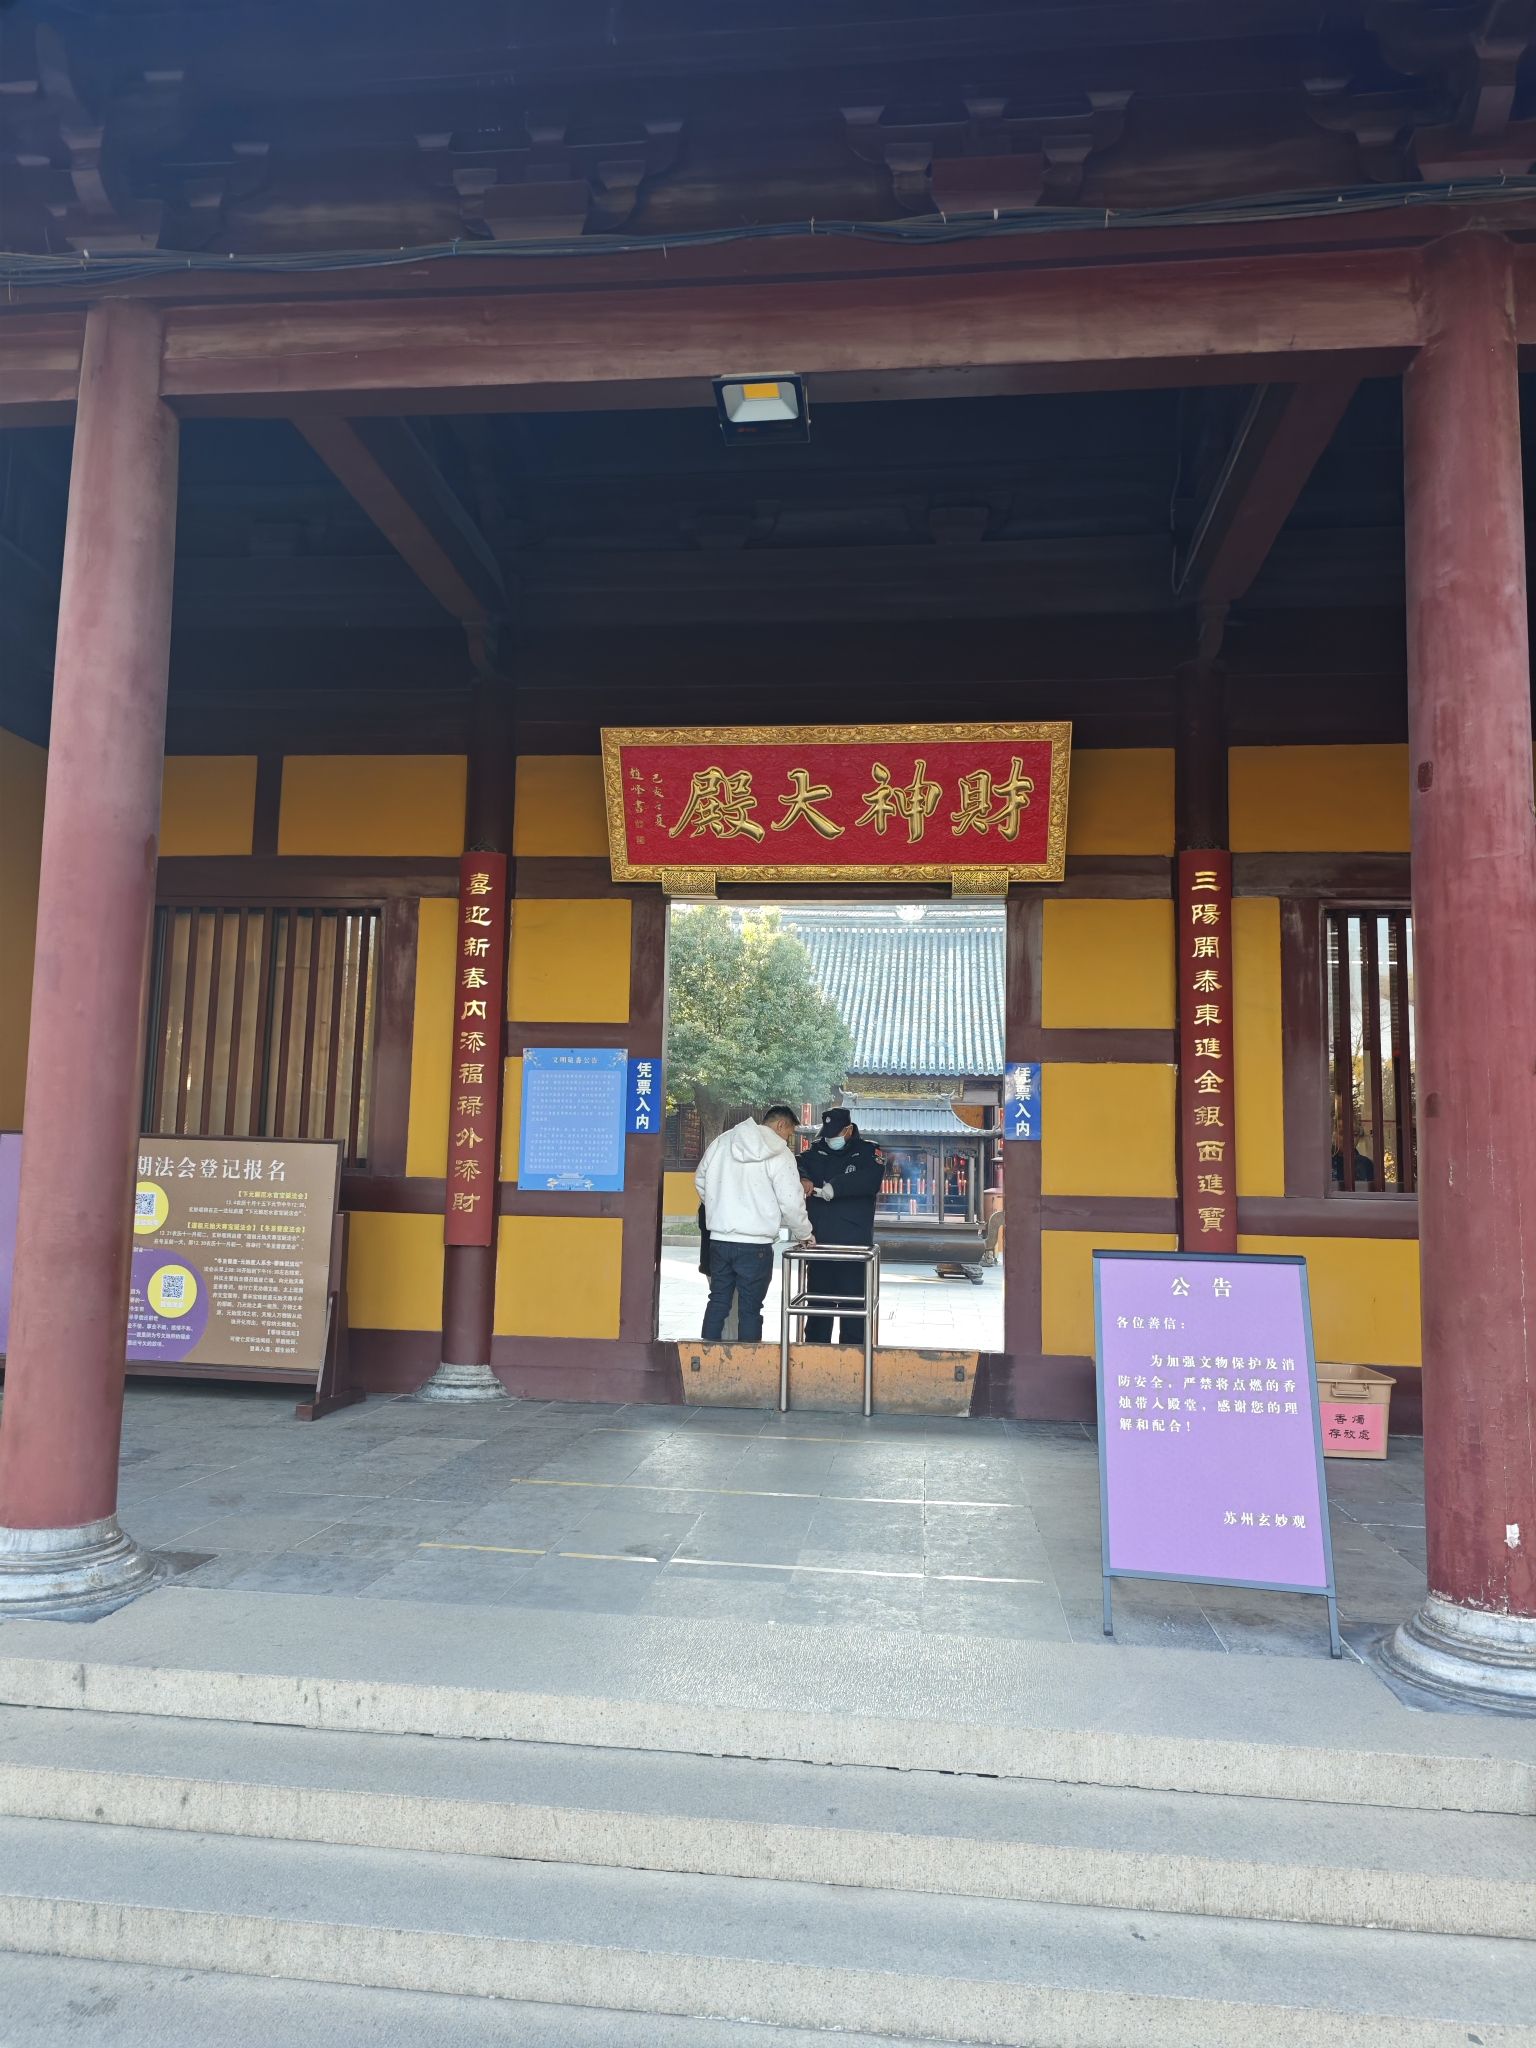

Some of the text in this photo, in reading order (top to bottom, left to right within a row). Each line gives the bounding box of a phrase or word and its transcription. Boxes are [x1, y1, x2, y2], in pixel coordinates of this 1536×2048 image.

[1191, 870, 1226, 1233] 三陽開泰東進金銀西進寶
[635, 1062, 653, 1130] 凭票入内
[1014, 1067, 1032, 1137] 凭票入内
[1150, 1354, 1296, 1372] 为加强文物保护及消
[1223, 1510, 1307, 1529] 苏州玄妙观
